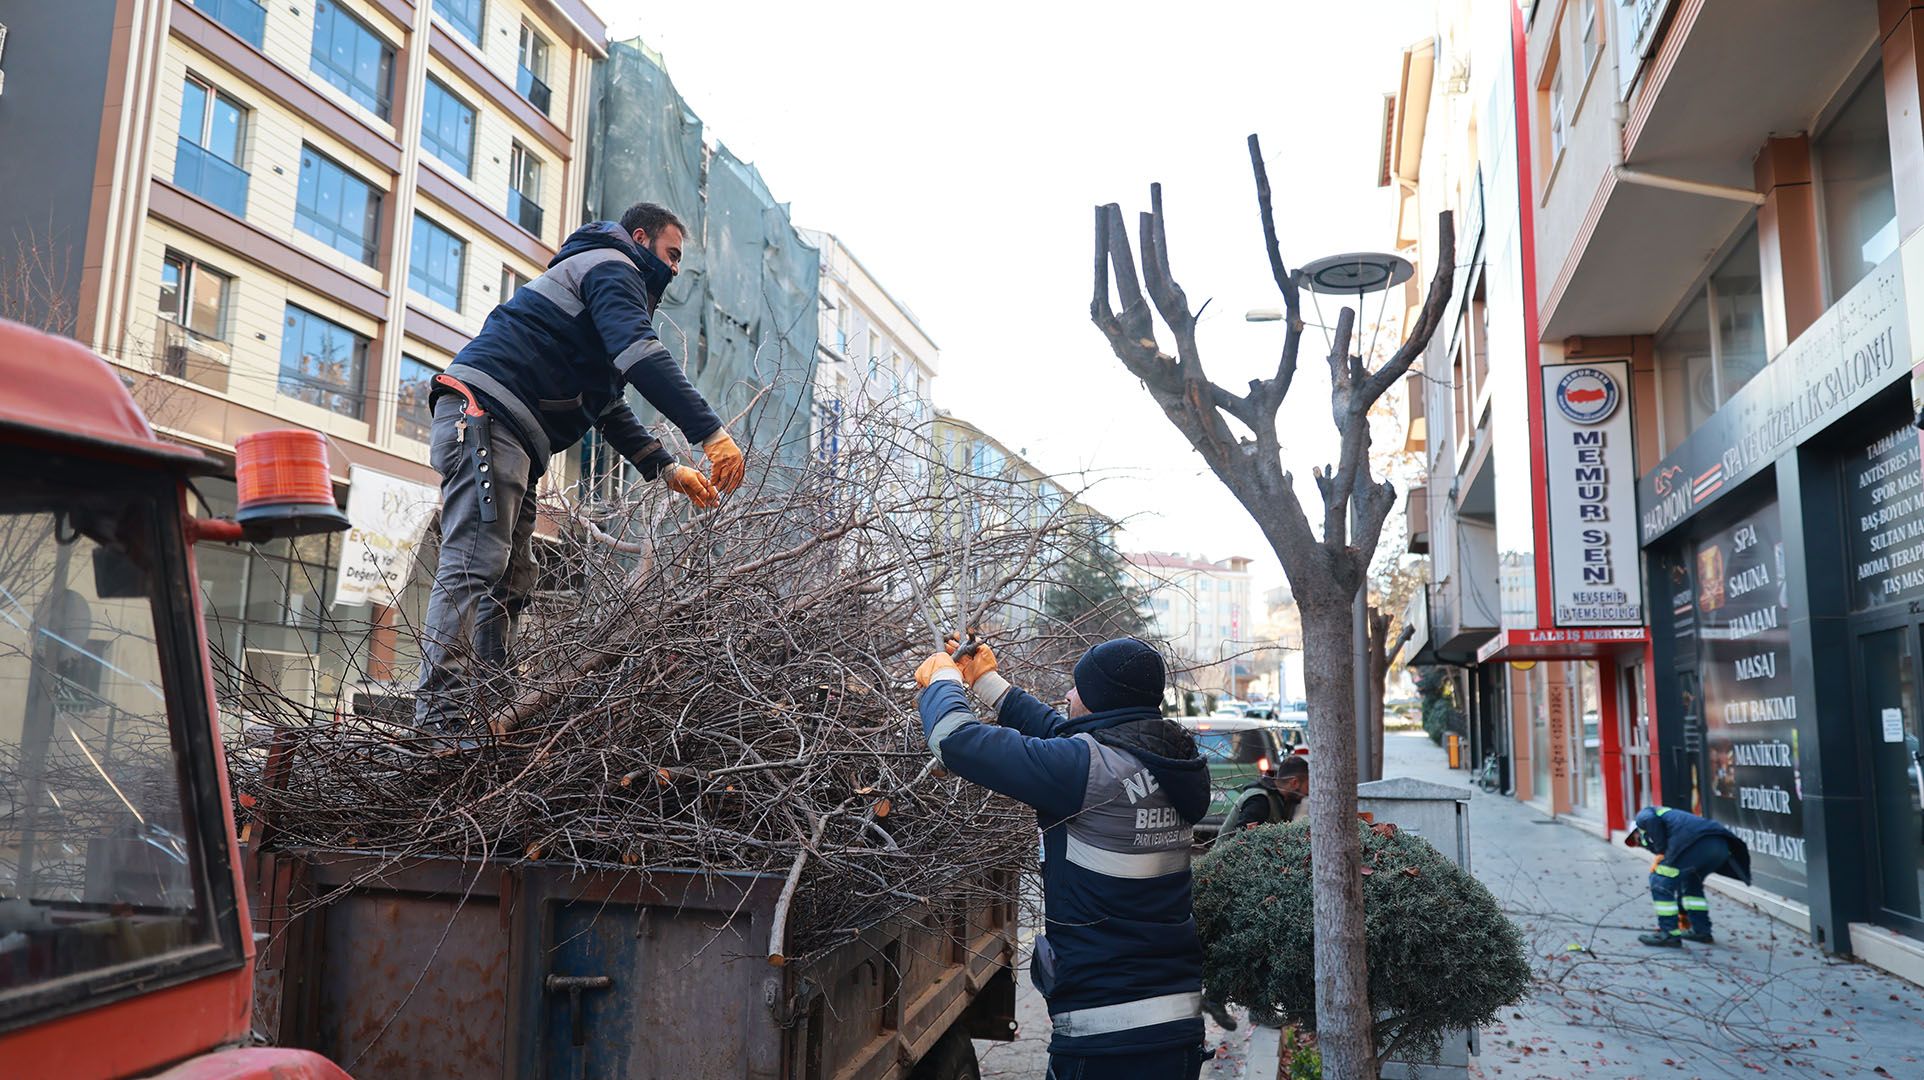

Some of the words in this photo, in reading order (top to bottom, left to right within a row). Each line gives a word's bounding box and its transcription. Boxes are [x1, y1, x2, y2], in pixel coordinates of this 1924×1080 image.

[1643, 477, 1693, 540] HARMONY
[1723, 443, 1744, 481] SPA
[1825, 326, 1894, 410] SALONU
[1573, 430, 1605, 520] MEMUR
[1859, 451, 1908, 488] ANTİSTRES
[1872, 481, 1898, 505] SPOR
[1861, 497, 1913, 532] BAŞ-BOYUN
[1733, 524, 1758, 553] SPA
[1870, 525, 1907, 552] SULTAN
[1583, 529, 1608, 582] SEN
[1858, 557, 1890, 580] AROMA
[1729, 563, 1770, 598] SAUNA
[1882, 576, 1901, 595] TAŞ
[1530, 630, 1565, 642] LALE
[1729, 605, 1777, 640] HAMAM
[1735, 652, 1775, 681] MASAJ
[1724, 699, 1749, 724] CİLT
[1749, 696, 1797, 723] BAKIMI
[1733, 740, 1792, 767] MANİKÜR
[1740, 784, 1792, 814] PEDİKÜR
